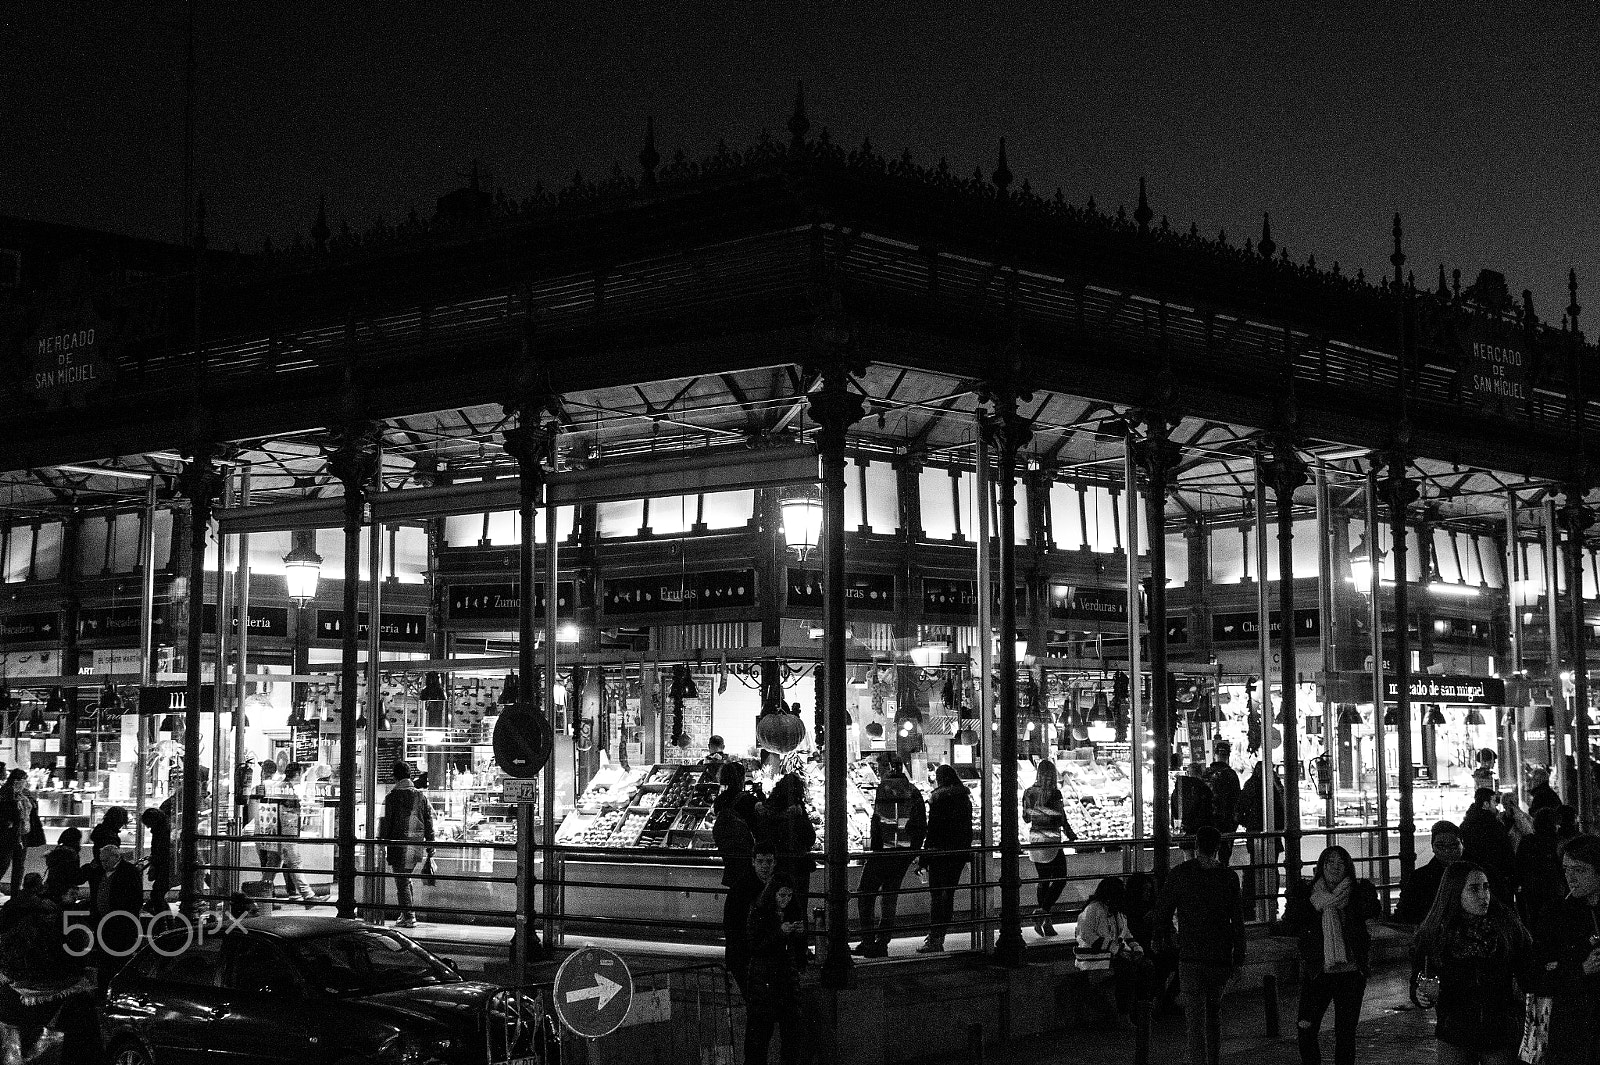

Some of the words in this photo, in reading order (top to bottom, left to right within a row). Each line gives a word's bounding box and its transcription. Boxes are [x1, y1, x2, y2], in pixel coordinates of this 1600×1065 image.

[38, 328, 95, 354] MERCADO
[58, 353, 73, 365] DE
[1473, 342, 1522, 366] MERCADO
[35, 370, 55, 389] SAN
[57, 364, 96, 384] MIGUEL
[1492, 364, 1505, 376] DE
[1473, 374, 1492, 392] SAN
[1493, 379, 1526, 400] MIGUEL
[660, 586, 698, 602] Frutas
[1079, 597, 1117, 613] Verduras
[1428, 680, 1440, 696] de
[1440, 685, 1457, 696] san
[1456, 682, 1485, 702] miguel
